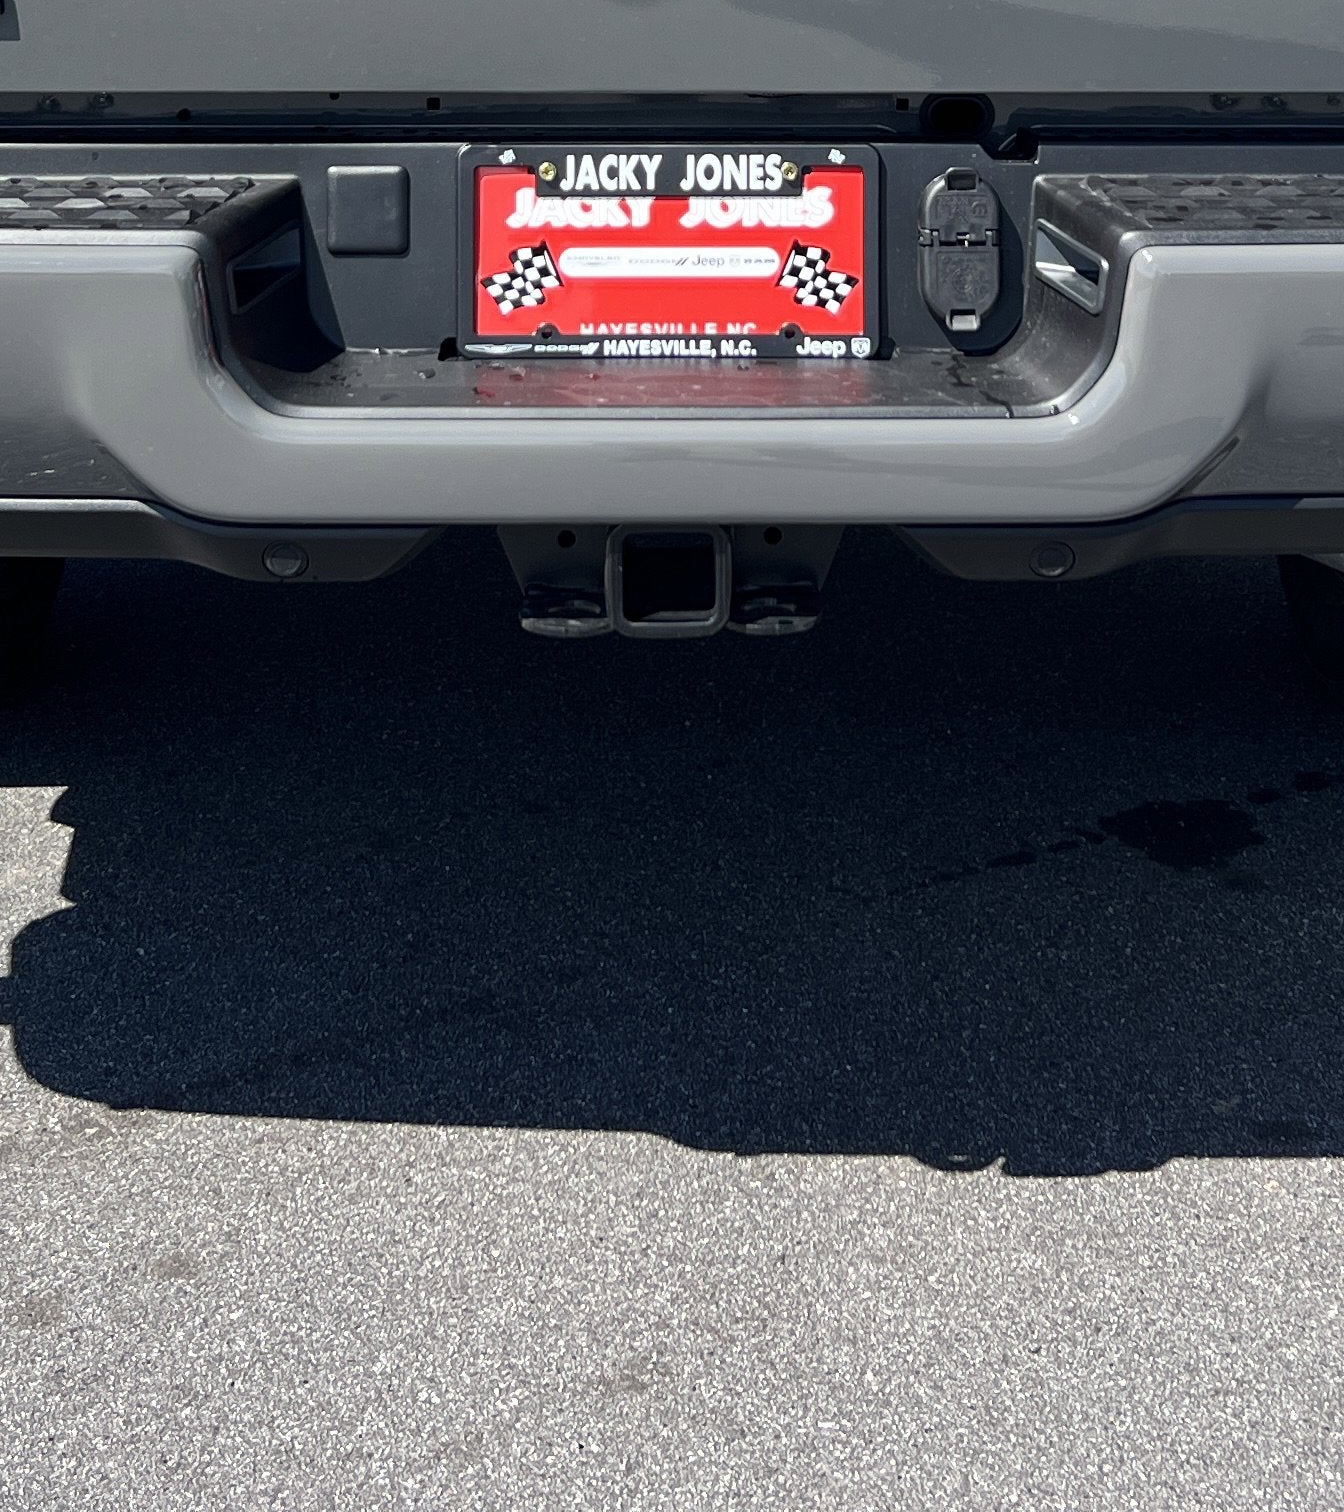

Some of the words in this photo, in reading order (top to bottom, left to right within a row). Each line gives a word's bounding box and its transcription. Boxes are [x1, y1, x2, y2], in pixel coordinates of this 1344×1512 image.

[560, 154, 662, 191] JACKY
[680, 154, 783, 191] JONES
[506, 187, 654, 228] JACKY
[679, 186, 834, 227] JONES
[692, 254, 725, 267] Jeep
[604, 339, 716, 358] HAYESVILLE,
[721, 339, 757, 356] N.C.
[796, 337, 846, 357] Jeep
